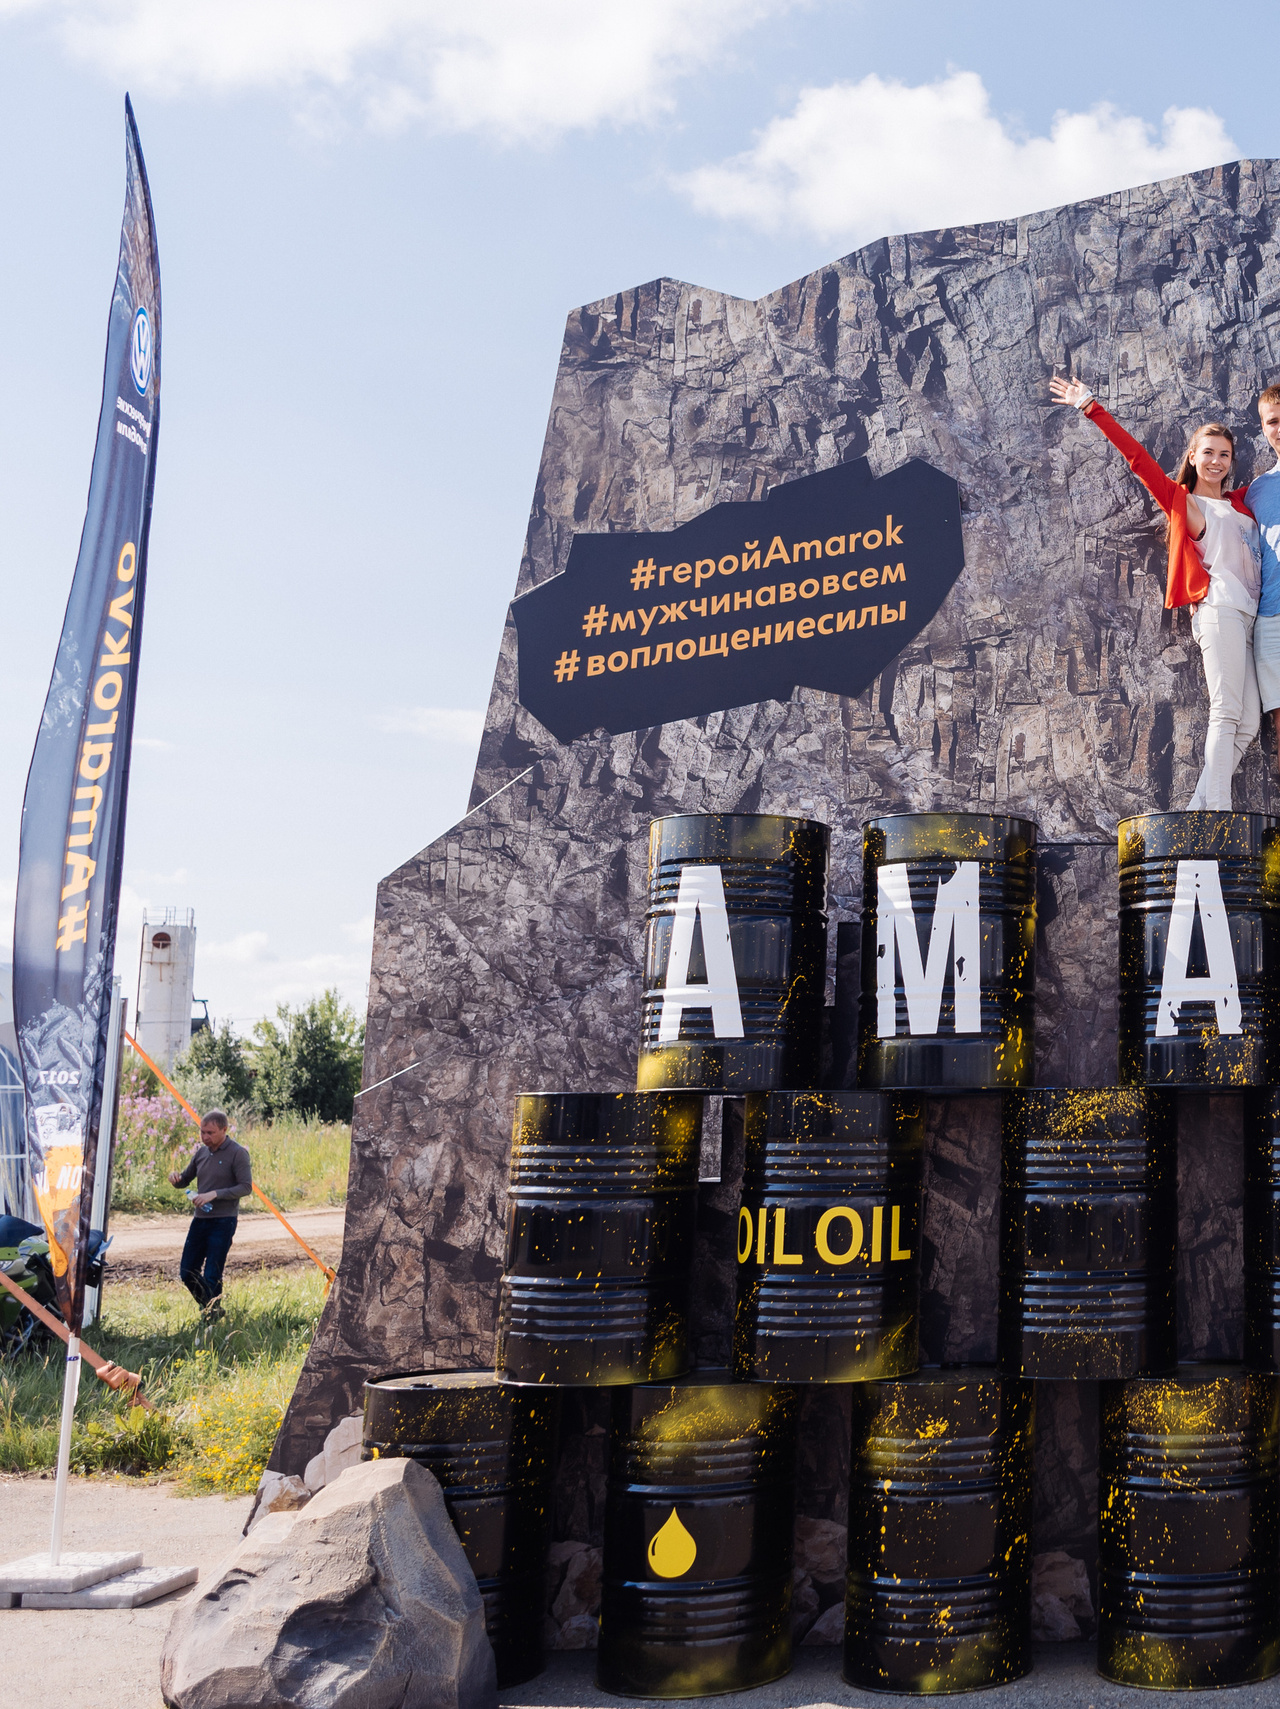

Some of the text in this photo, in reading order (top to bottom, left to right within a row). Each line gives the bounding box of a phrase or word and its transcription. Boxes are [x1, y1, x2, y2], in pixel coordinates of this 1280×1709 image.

[630, 514, 904, 591] #геройAmarok
[582, 562, 907, 637] #мужчинавовсем
[737, 1205, 911, 1265] OIL OIL
